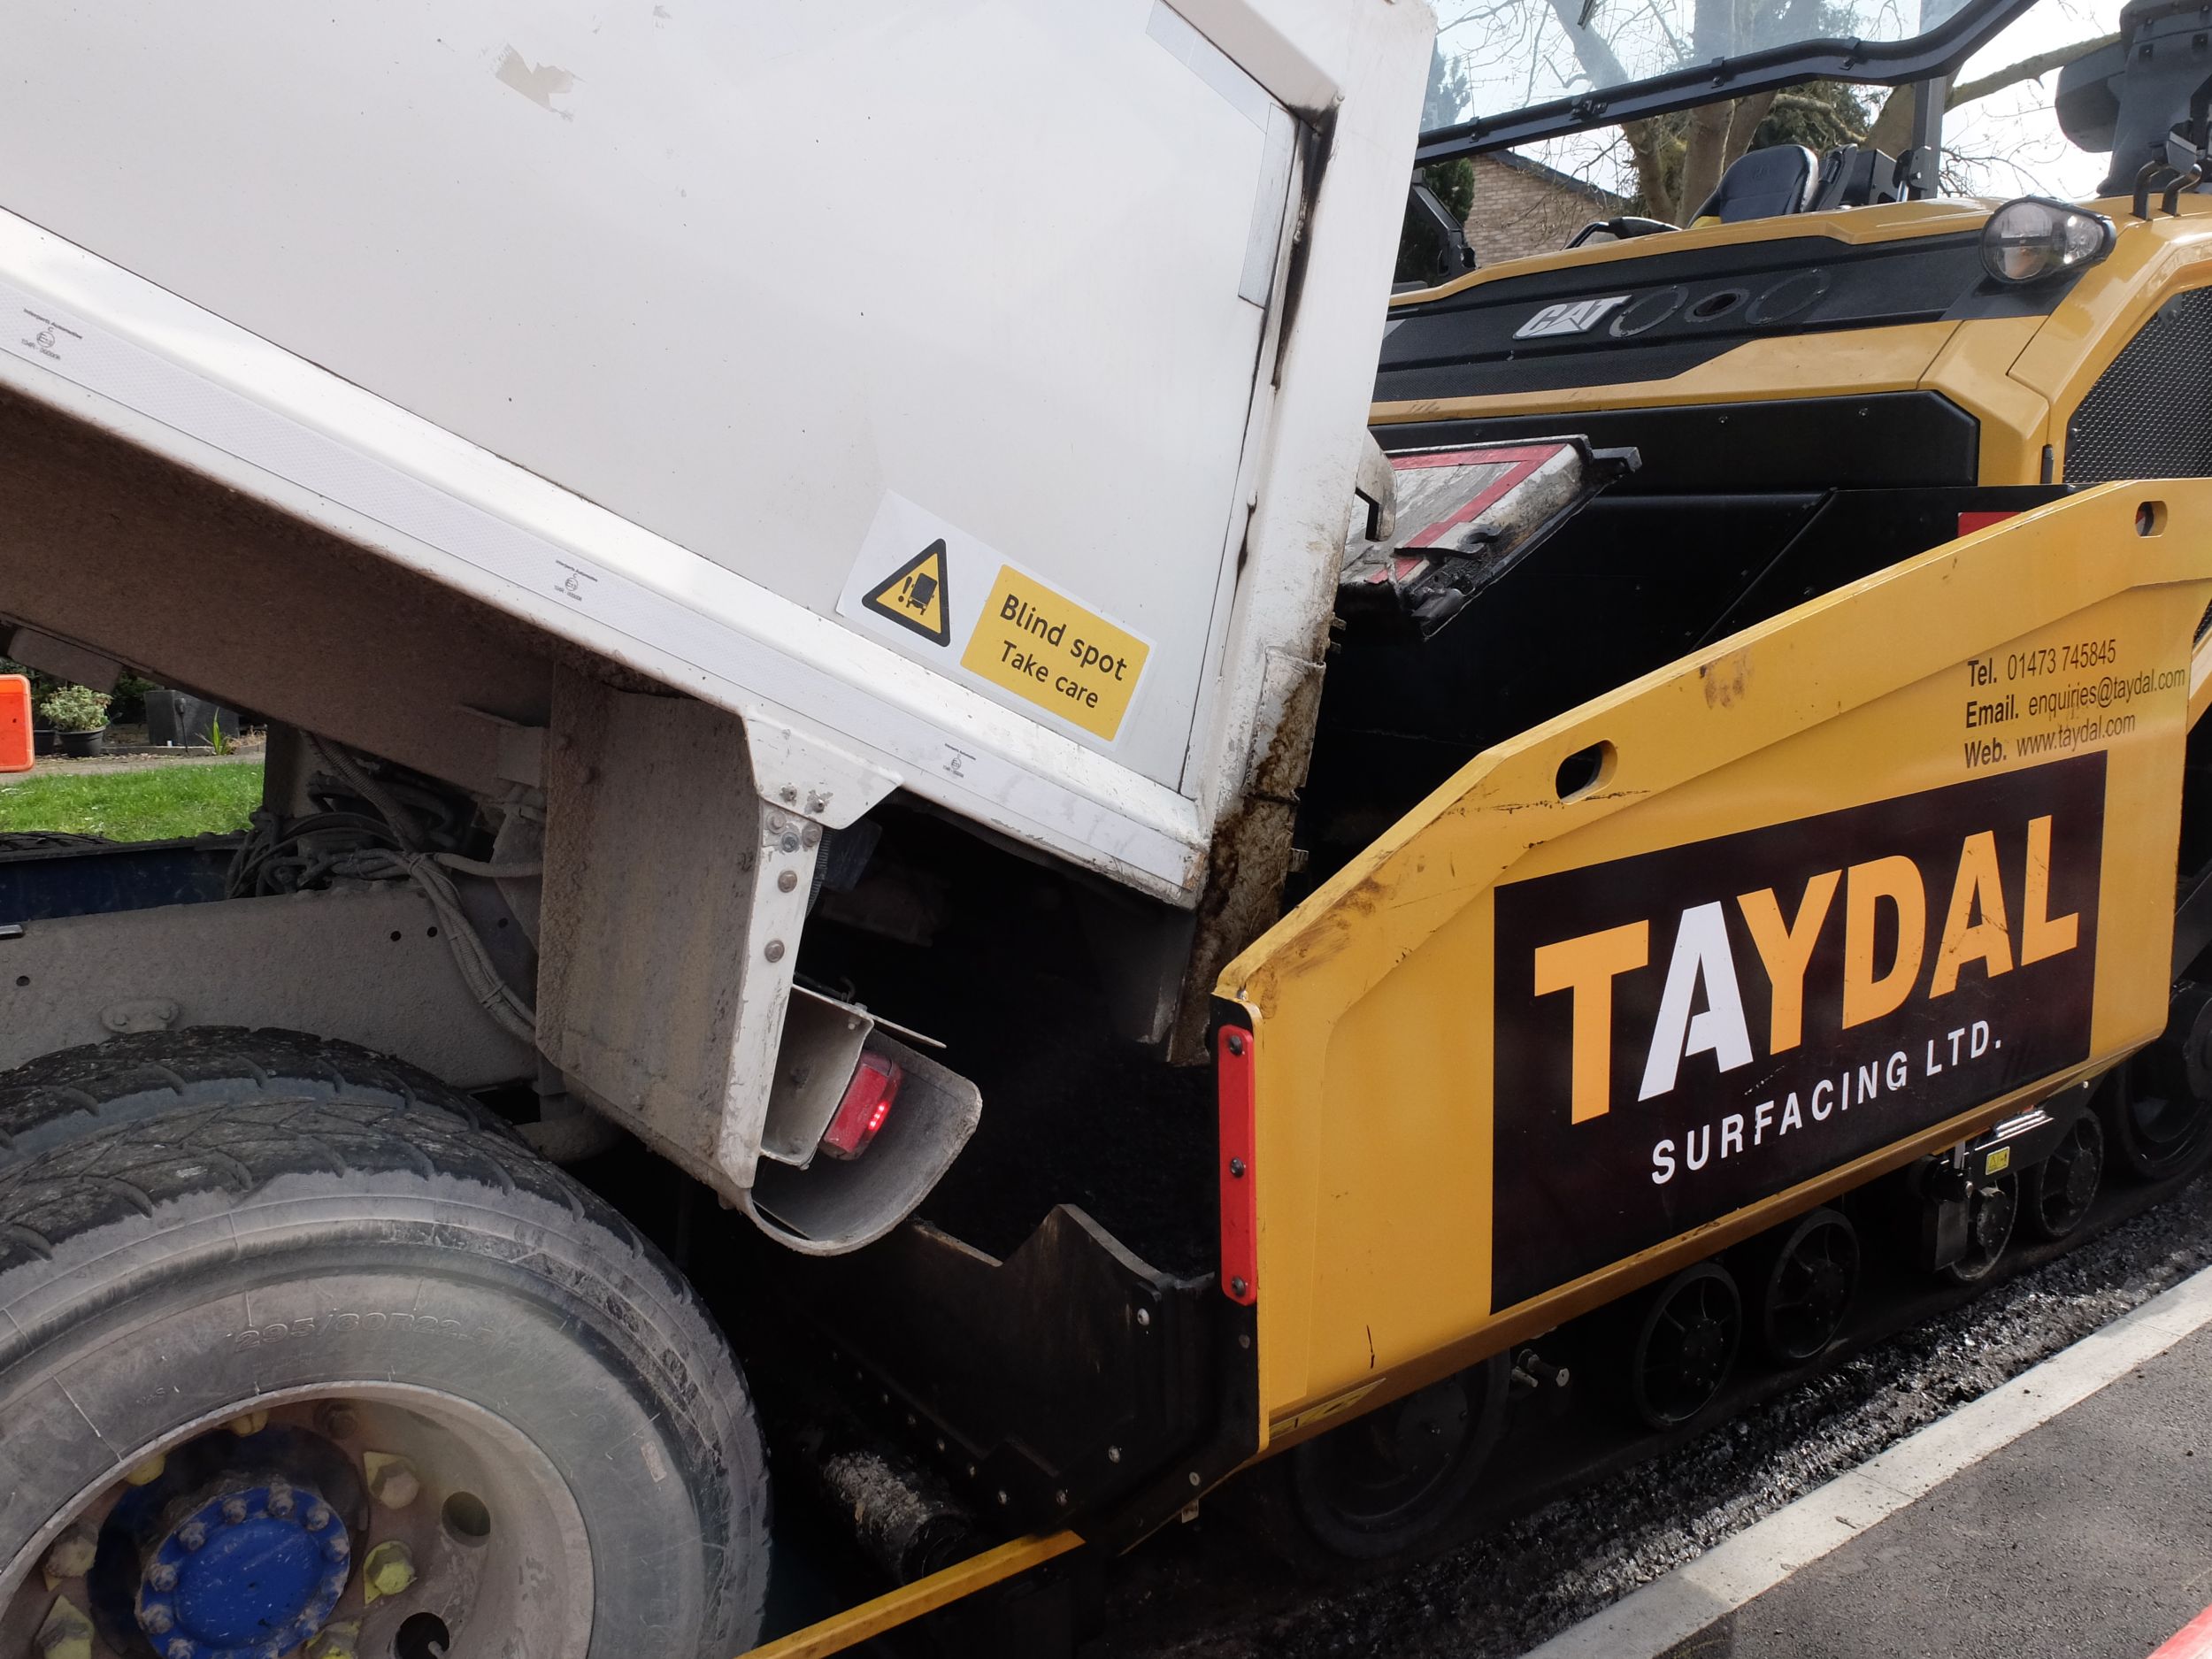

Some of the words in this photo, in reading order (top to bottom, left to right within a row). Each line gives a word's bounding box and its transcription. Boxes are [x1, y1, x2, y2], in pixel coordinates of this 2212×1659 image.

[1515, 294, 1632, 339] CAT
[999, 593, 1067, 647] Blind
[1070, 638, 1127, 681] spot
[1967, 658, 1997, 687] Tel.
[2008, 648, 2057, 680] 01473
[2062, 639, 2116, 673] 745845
[1001, 641, 1049, 682] Take
[1055, 674, 1099, 708] care
[1965, 695, 2018, 728] Email.
[2029, 668, 2185, 721] enquiries@taydal.com
[1964, 737, 2007, 769] Web.
[2016, 713, 2136, 757] www.taydal.com
[1533, 814, 2079, 1125] TAYDAL
[1650, 1050, 1908, 1186] SURFACING
[1926, 1019, 2002, 1078] LTD.
